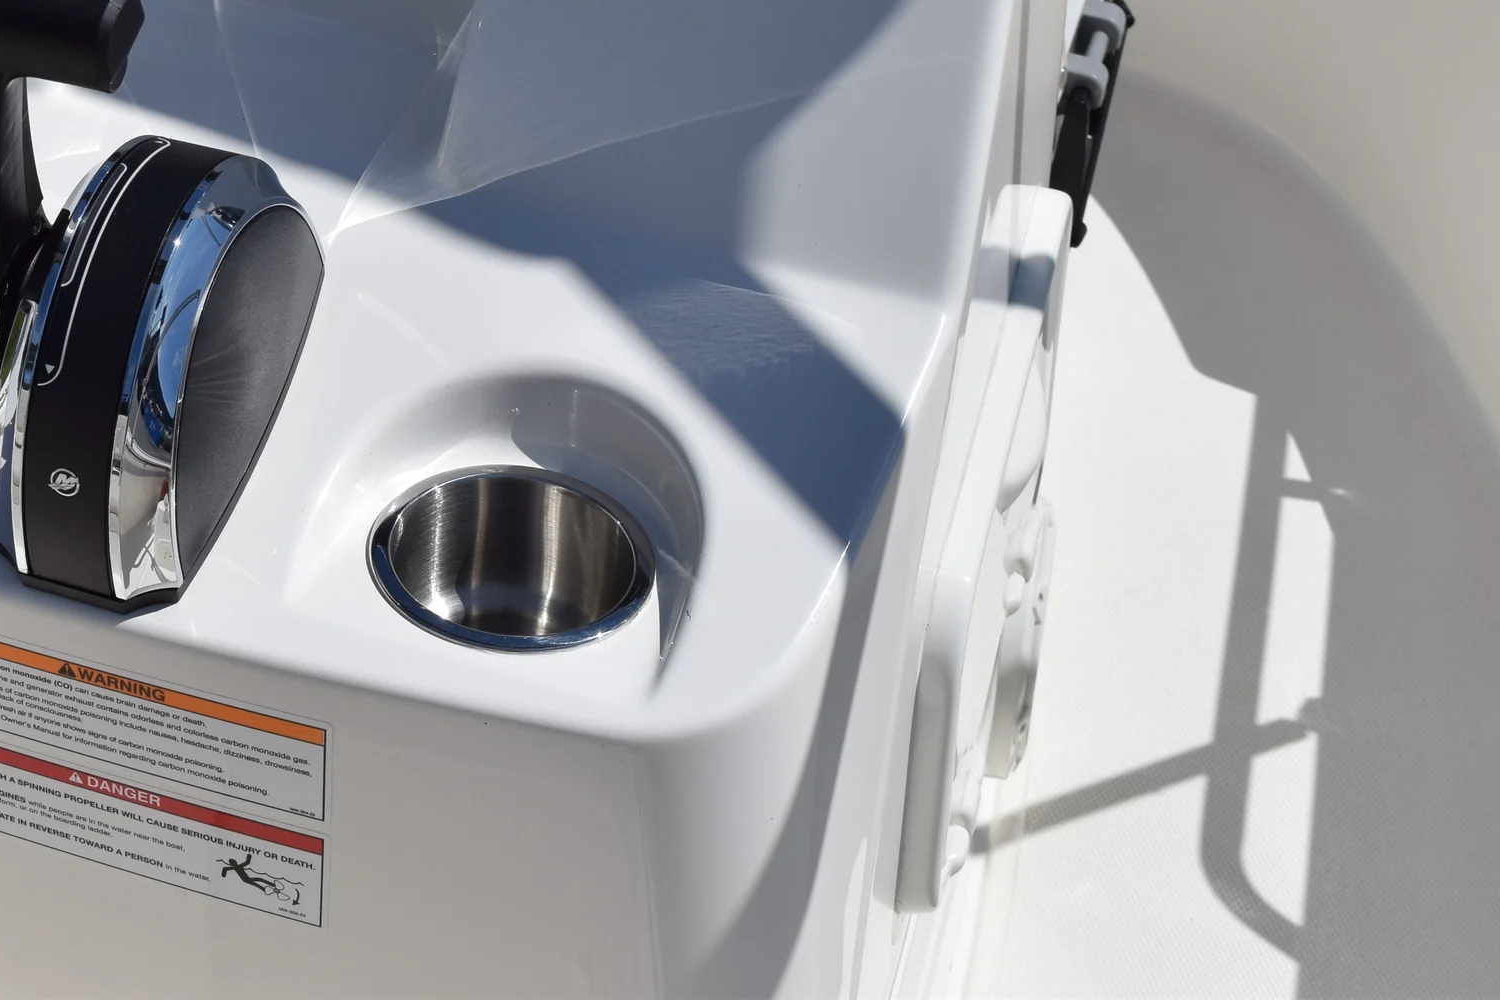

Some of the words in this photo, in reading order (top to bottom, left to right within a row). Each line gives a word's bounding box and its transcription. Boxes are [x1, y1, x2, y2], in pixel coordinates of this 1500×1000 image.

[12, 668, 52, 684] monoxide
[53, 679, 73, 691] (CO)
[74, 686, 89, 695] can
[90, 691, 115, 702] cause
[116, 697, 136, 708] brain
[137, 704, 170, 718] damage
[182, 716, 207, 728] death.
[77, 666, 165, 702] WARNING
[9, 678, 25, 687] and
[25, 683, 63, 698] generator
[64, 694, 94, 707] exhaust
[95, 703, 129, 717] contains
[130, 713, 165, 727] odorless
[165, 723, 181, 732] and
[183, 727, 219, 742] colorless
[220, 737, 249, 750] carbon
[250, 745, 291, 761] monoxide
[292, 756, 310, 765] gas.
[87, 775, 160, 807] DANGER
[8, 776, 16, 784] A
[17, 778, 62, 798] SPINNING
[63, 792, 119, 815] PROPELLER
[120, 809, 144, 822] WILL
[145, 817, 179, 833] CAUSE
[180, 827, 224, 845] SERIOUS
[225, 840, 261, 855] INJURY
[263, 850, 278, 860] OR
[280, 855, 316, 871] DEATH.
[17, 818, 27, 826] IN
[29, 821, 71, 840] REVERSE
[72, 834, 114, 853] TOWARD
[115, 848, 123, 856] A
[124, 850, 163, 868] PERSON
[174, 866, 186, 874] the
[188, 871, 210, 882] water.
[27, 800, 47, 810] while
[48, 806, 73, 818] people
[75, 814, 87, 822] are
[88, 817, 95, 825] in
[97, 820, 109, 829] the
[110, 825, 132, 835] water
[133, 832, 150, 841] near
[151, 836, 164, 845] the
